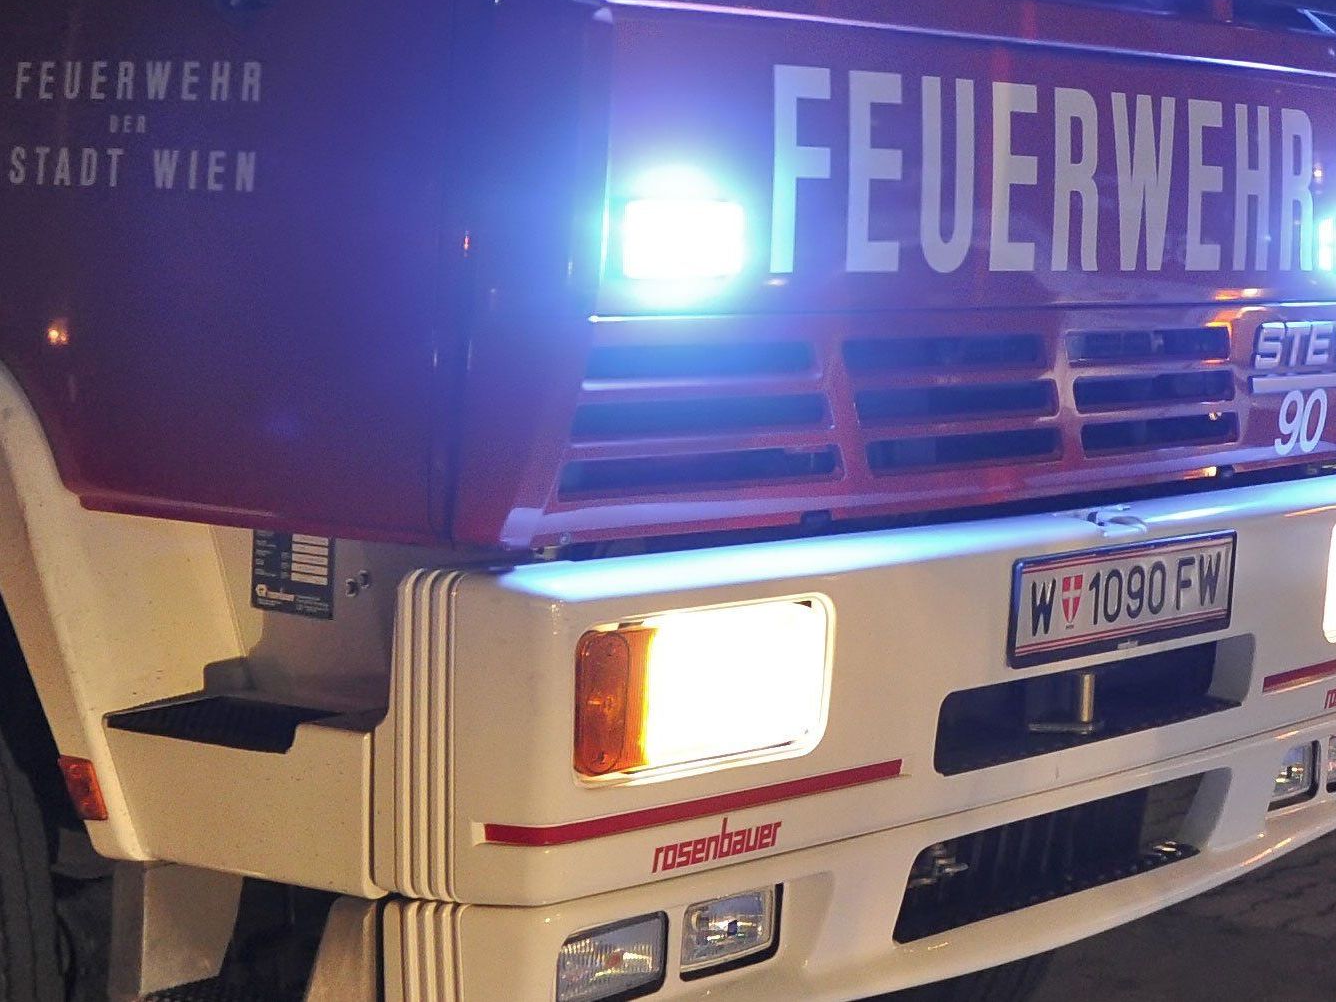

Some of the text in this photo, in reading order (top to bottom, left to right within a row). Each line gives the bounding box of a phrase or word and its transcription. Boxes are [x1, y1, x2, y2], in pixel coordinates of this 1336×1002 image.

[15, 60, 262, 101] FEUERWEHR
[109, 114, 146, 133] DER
[8, 146, 256, 192] STADT WIEN
[768, 63, 1315, 273] FEUERWEHR
[1274, 388, 1328, 456] 90
[1031, 551, 1221, 637] W 1090 FW
[651, 817, 783, 874] rosenbauer
